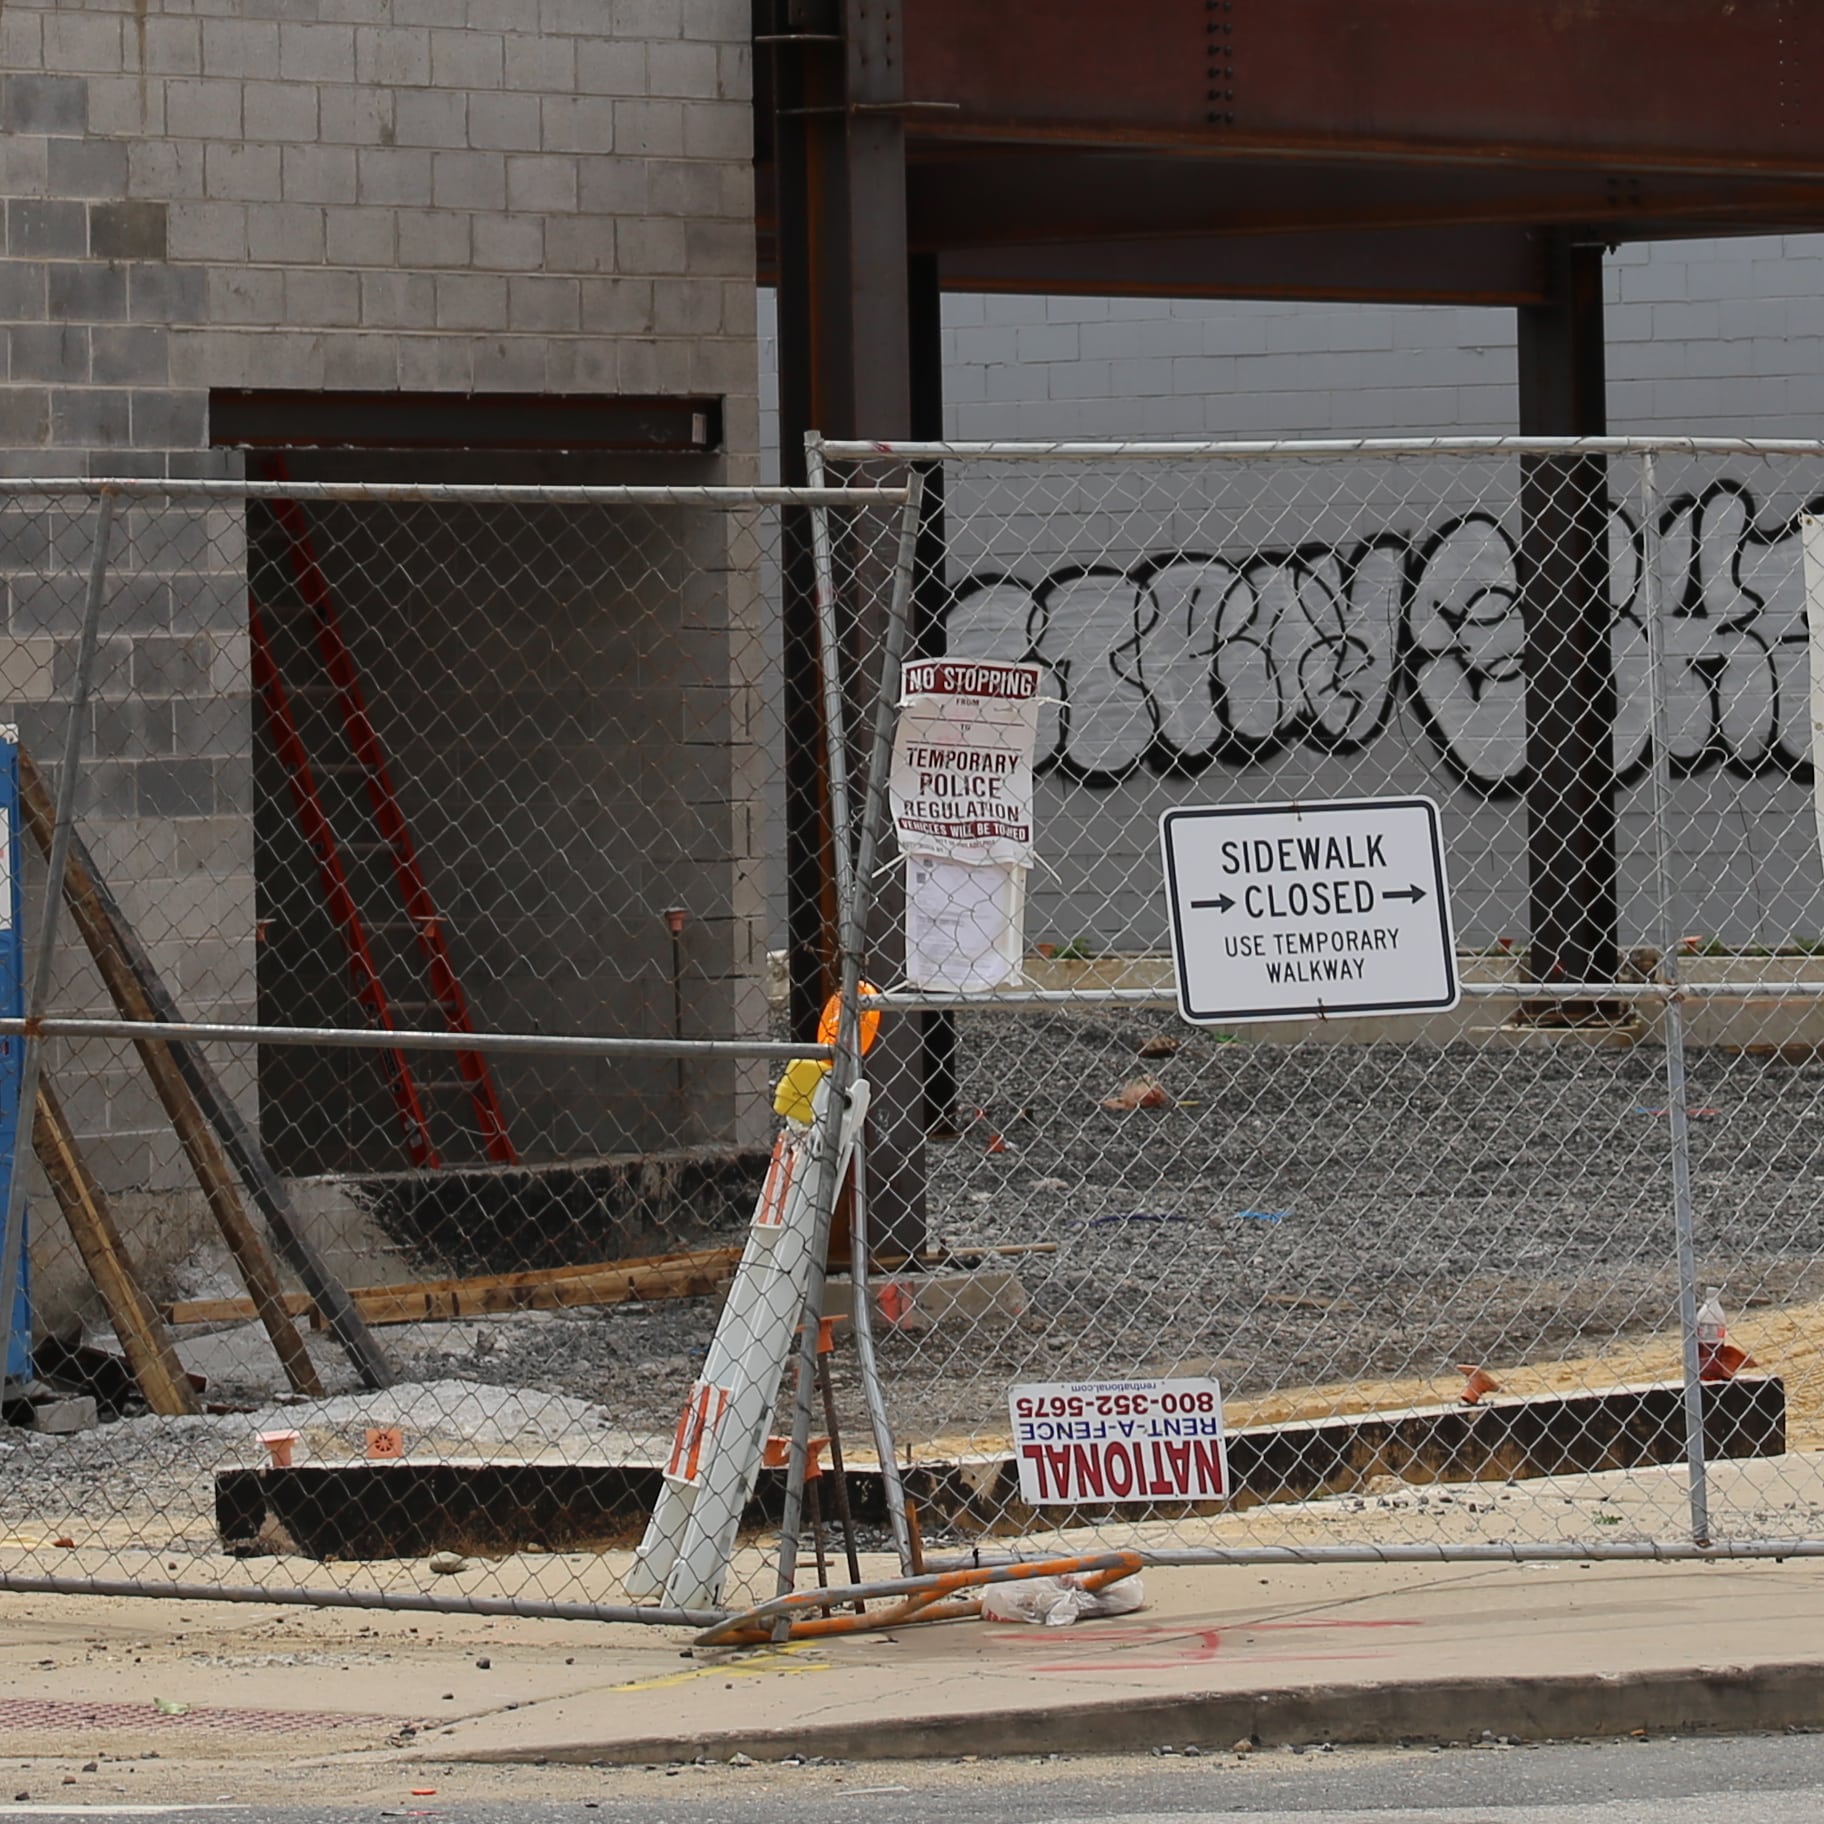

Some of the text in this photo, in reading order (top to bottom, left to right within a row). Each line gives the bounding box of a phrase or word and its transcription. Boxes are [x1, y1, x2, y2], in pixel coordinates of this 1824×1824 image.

[909, 665, 1033, 696] NO STOPPING
[907, 747, 1019, 774] TEMPORARY
[919, 772, 1001, 799] POLICE
[904, 800, 1019, 822] REGULATION
[901, 818, 1026, 841] VEHICLES WILL BE TOWED
[1221, 834, 1387, 874] SIDEWALK
[1244, 880, 1374, 918] CLOSED
[1225, 928, 1399, 957] USE TEMPORARY
[1266, 958, 1365, 983] WALKWAY
[1071, 1382, 1157, 1393] rentnational.com
[1016, 1392, 1214, 1418] 800-352-5675
[1020, 1417, 1217, 1441] RENT-A-FENCE
[1022, 1439, 1223, 1499] NATIONAL
